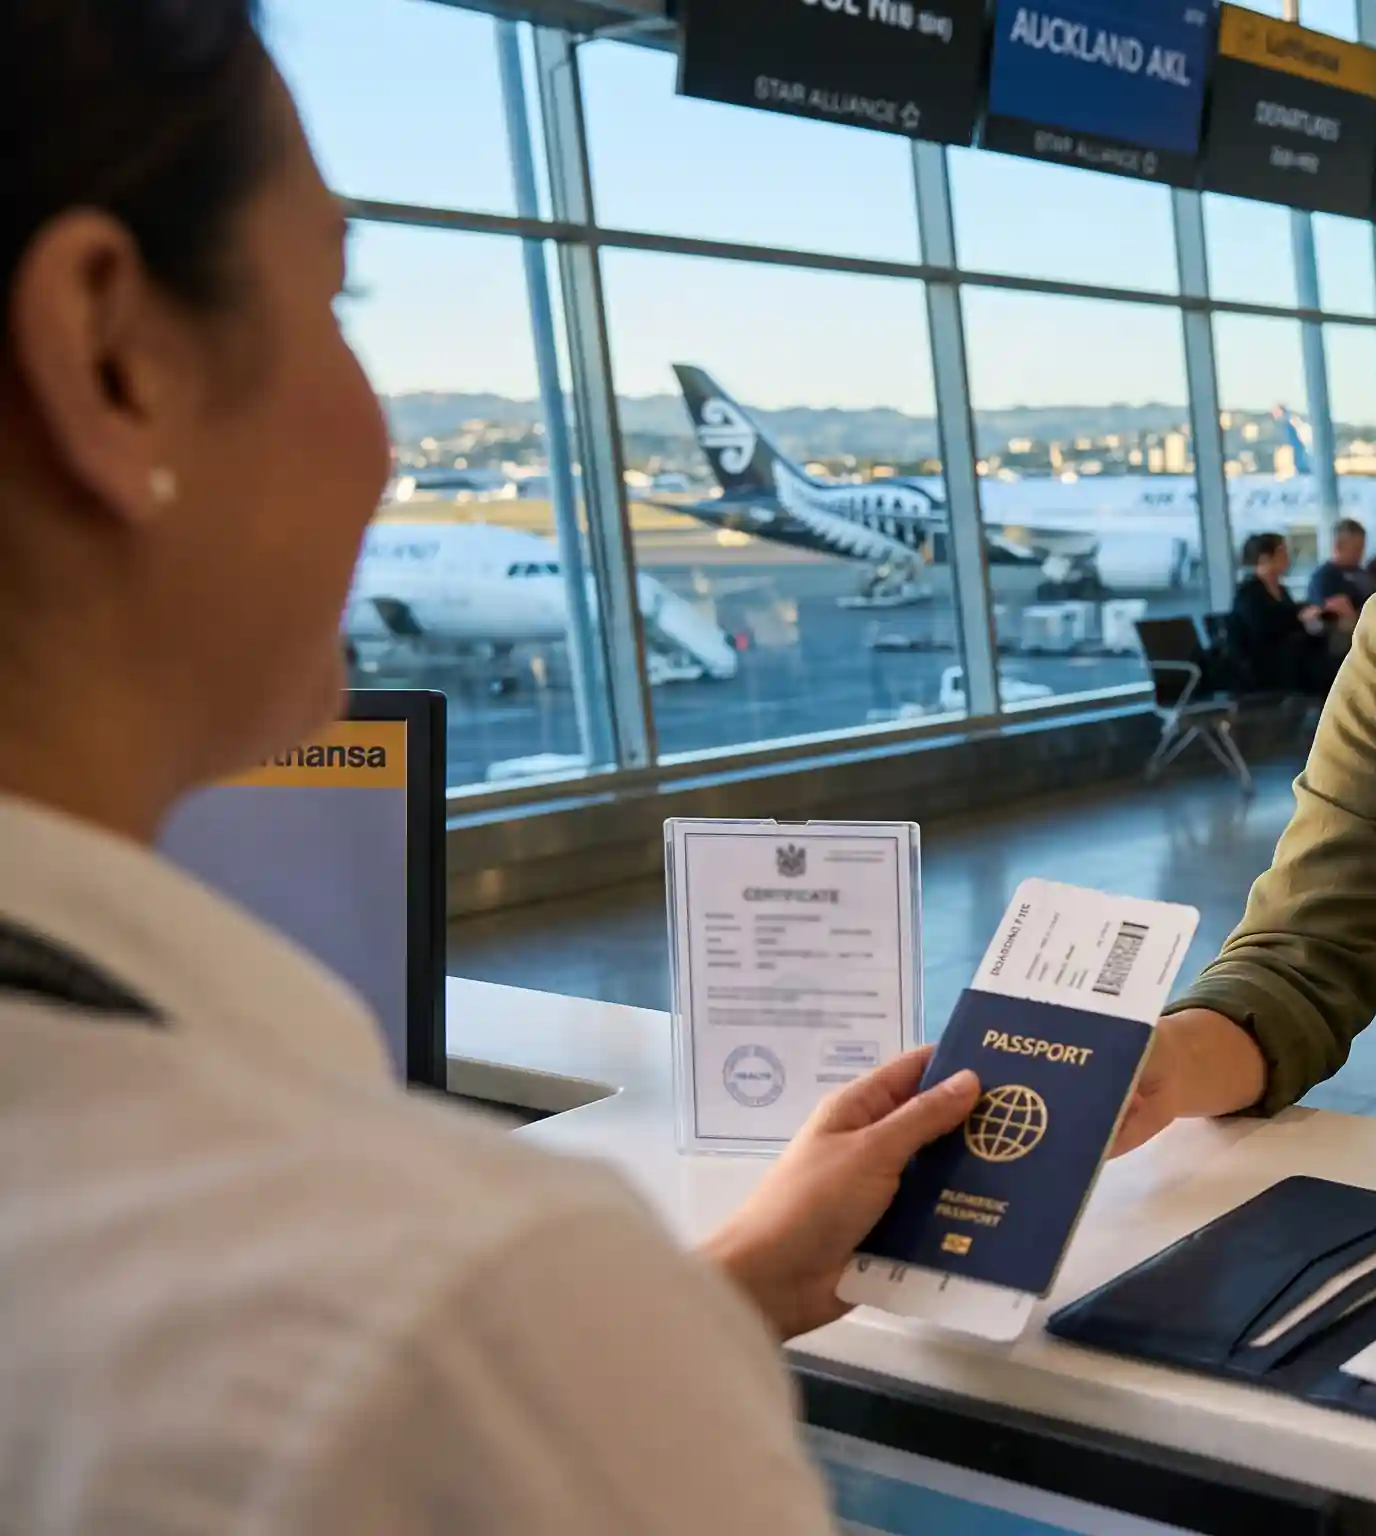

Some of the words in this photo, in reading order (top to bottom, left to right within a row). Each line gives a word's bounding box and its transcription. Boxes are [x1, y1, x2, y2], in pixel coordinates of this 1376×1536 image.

[1010, 7, 1143, 73] AUCKLAND
[1146, 45, 1190, 86] AKL
[754, 75, 806, 105] STAR
[809, 88, 898, 124] ALLIANCE
[743, 887, 841, 904] CERTIFICATE
[981, 1028, 1094, 1068] PASSPORT
